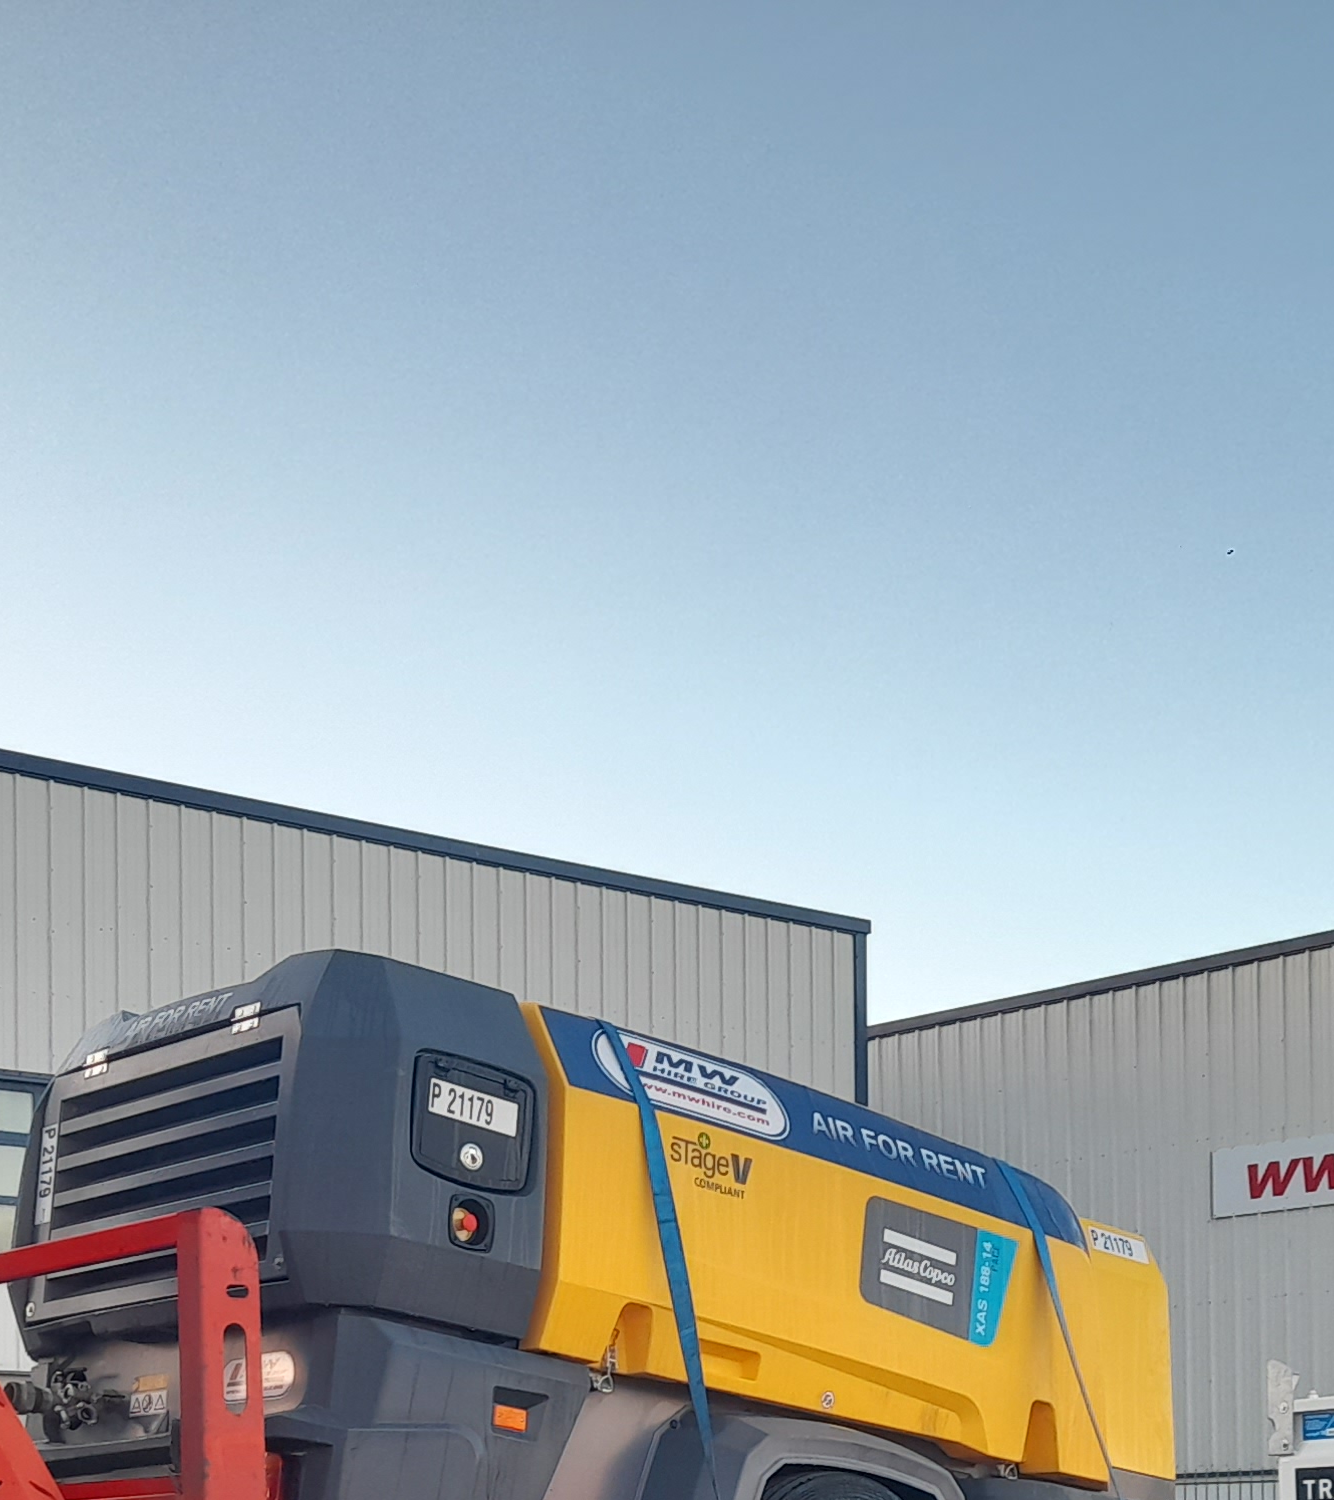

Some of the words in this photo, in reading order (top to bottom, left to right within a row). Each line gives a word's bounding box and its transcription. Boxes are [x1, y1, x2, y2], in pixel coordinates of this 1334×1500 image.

[150, 1005, 186, 1028] FOR
[186, 991, 235, 1017] RENT
[652, 1065, 698, 1085] HIRE
[703, 1080, 768, 1107] GROUP
[654, 1050, 741, 1087] MW
[430, 1081, 442, 1109] P
[446, 1087, 494, 1127] 21179
[45, 1127, 57, 1140] P
[812, 1111, 858, 1148] AIR
[860, 1127, 917, 1168] FOR
[919, 1147, 987, 1190] RENT
[38, 1144, 56, 1199] 21179
[693, 1176, 746, 1200] COMPLIANT
[1090, 1229, 1099, 1247] P
[1101, 1232, 1134, 1257] 21179
[881, 1247, 920, 1274] Atlas
[919, 1259, 956, 1287] Copco
[979, 1241, 993, 1294] 188-14
[975, 1298, 989, 1337] XAS
